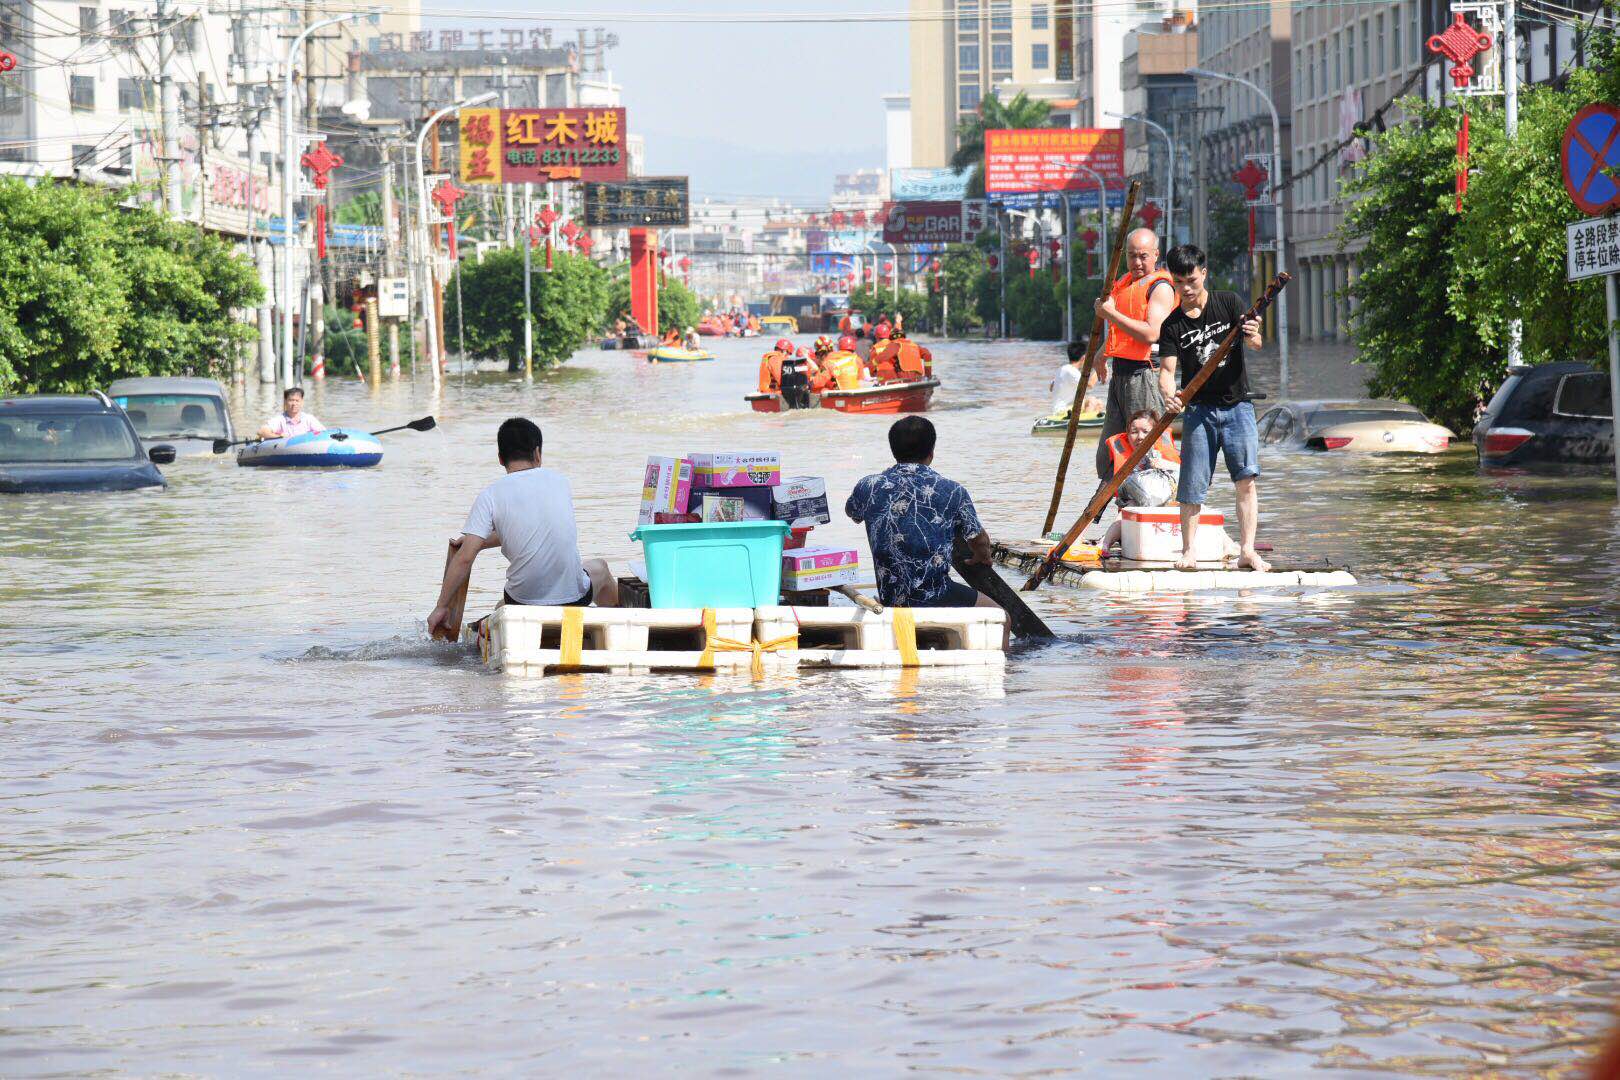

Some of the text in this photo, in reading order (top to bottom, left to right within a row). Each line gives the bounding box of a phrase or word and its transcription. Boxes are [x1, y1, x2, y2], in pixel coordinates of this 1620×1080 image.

[506, 111, 620, 145] 红木城
[543, 148, 620, 163] 83712233
[1574, 222, 1620, 250] 全路段禁
[782, 366, 793, 375] 50
